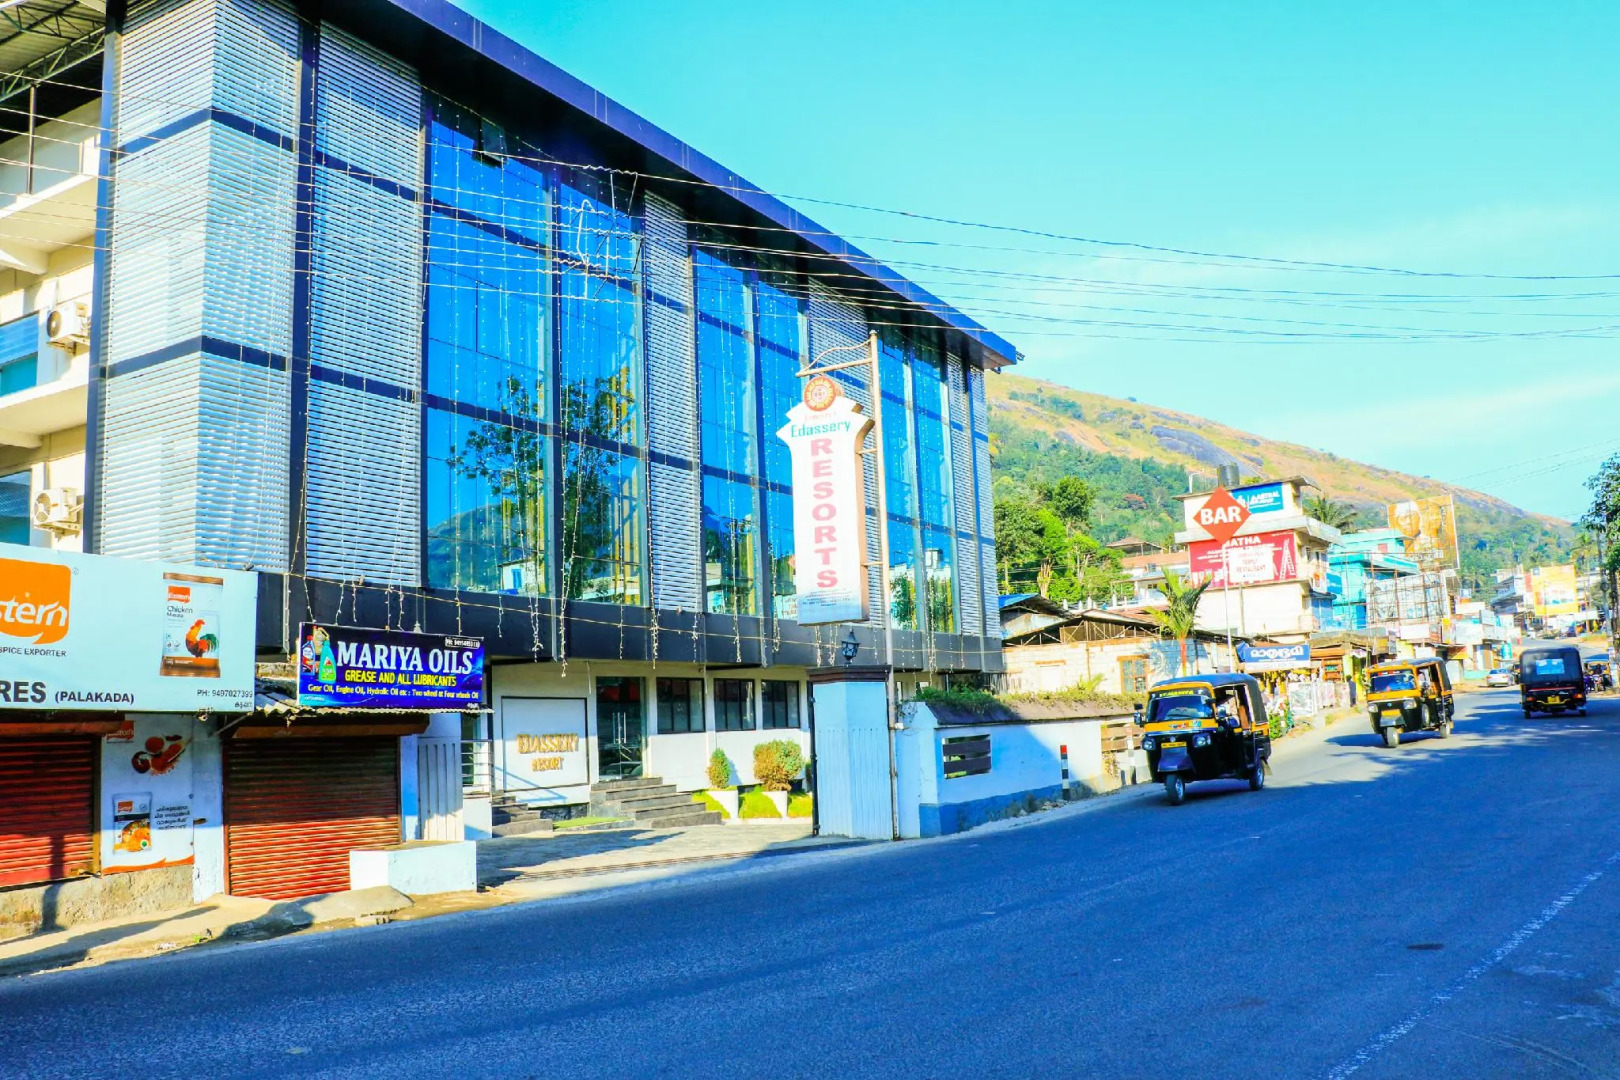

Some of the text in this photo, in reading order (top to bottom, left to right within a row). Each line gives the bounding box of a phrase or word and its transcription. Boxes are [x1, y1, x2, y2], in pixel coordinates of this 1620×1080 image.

[790, 421, 851, 438] Edassery
[810, 437, 839, 588] RESORTS
[1200, 506, 1242, 525] BAR
[0, 596, 68, 627] tern
[167, 606, 193, 614] Chicken
[24, 648, 67, 657] EXPORTER
[336, 640, 473, 675] MARIYA OILS
[345, 670, 457, 687] GREASE AND ALL LUBRICANTS
[54, 691, 135, 705] (PALAKADA)
[196, 689, 210, 697] PH:
[516, 733, 579, 754] EDASSERY
[531, 757, 564, 772] RESORT
